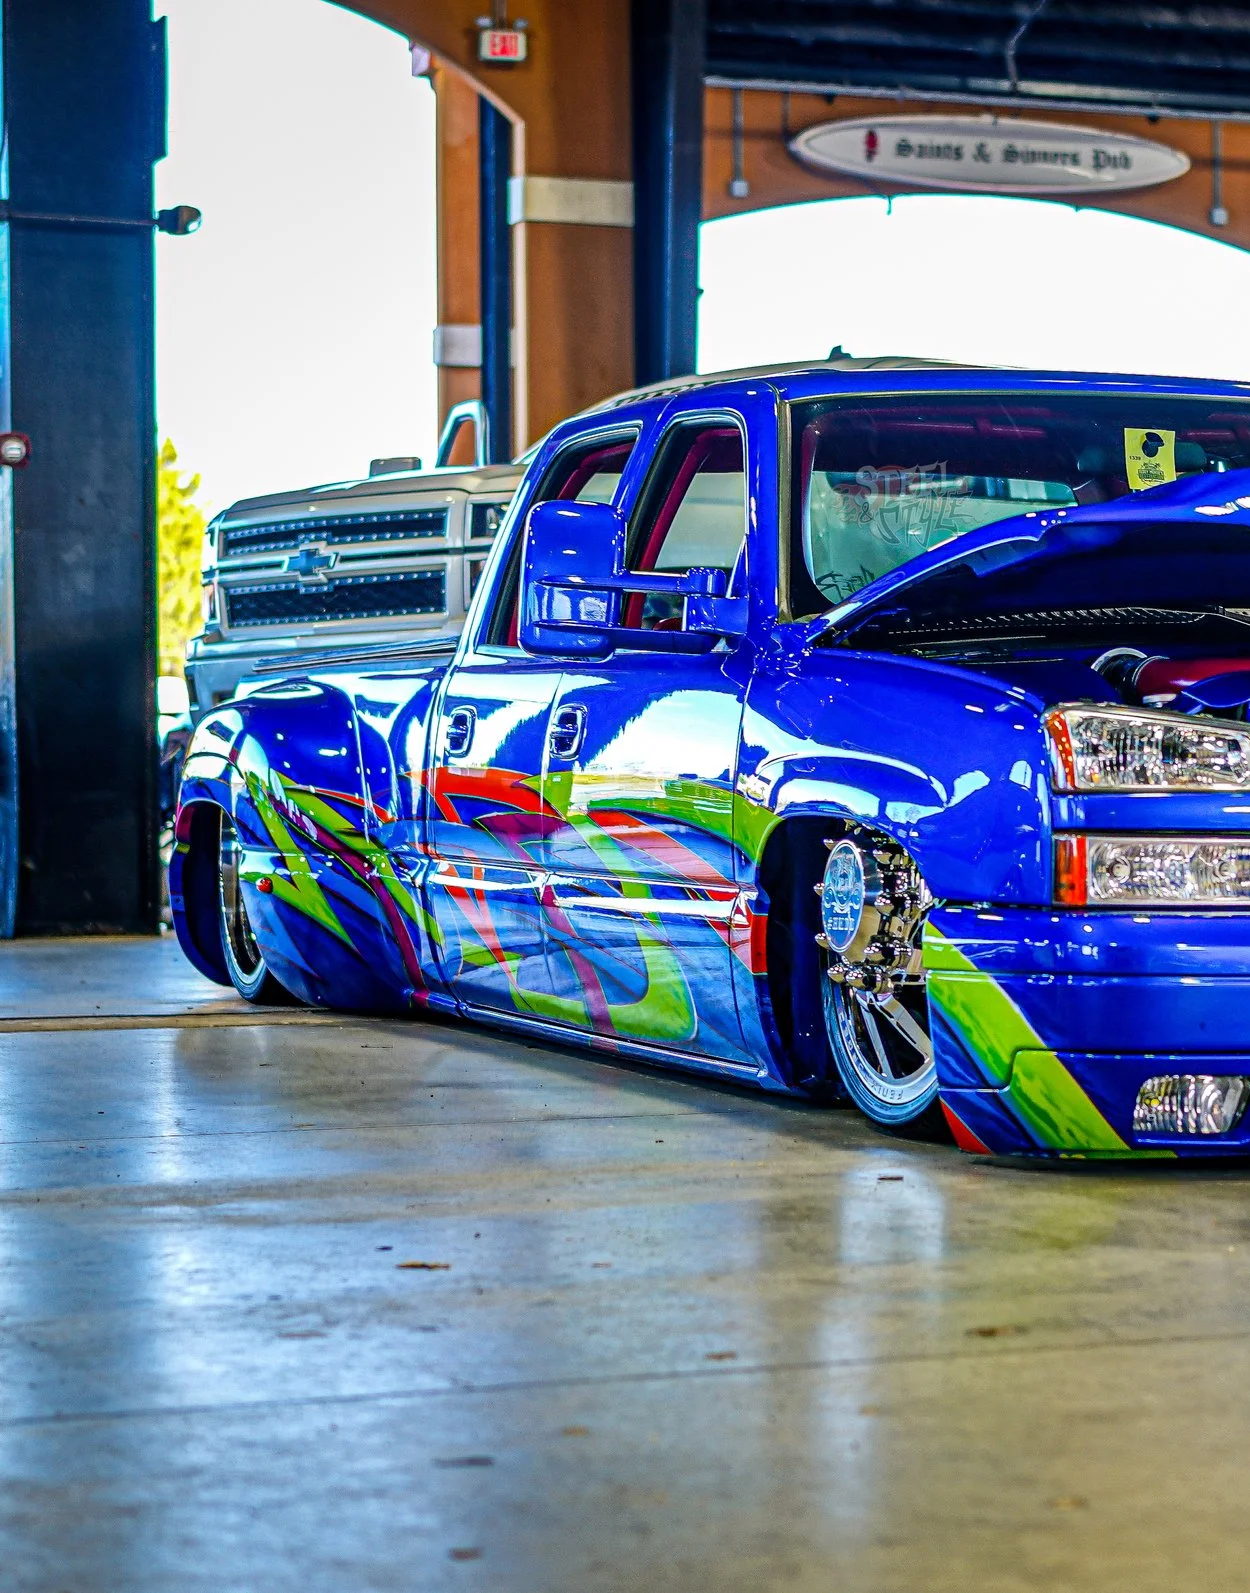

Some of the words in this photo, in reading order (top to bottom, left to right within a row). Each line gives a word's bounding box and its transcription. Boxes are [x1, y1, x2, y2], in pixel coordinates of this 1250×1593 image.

[895, 138, 964, 162] Saints
[972, 142, 992, 163] &
[1001, 145, 1081, 166] Sinners
[1091, 148, 1132, 170] Pub
[855, 460, 968, 506] STEEL
[860, 502, 872, 523] &
[876, 489, 974, 549] STYLE
